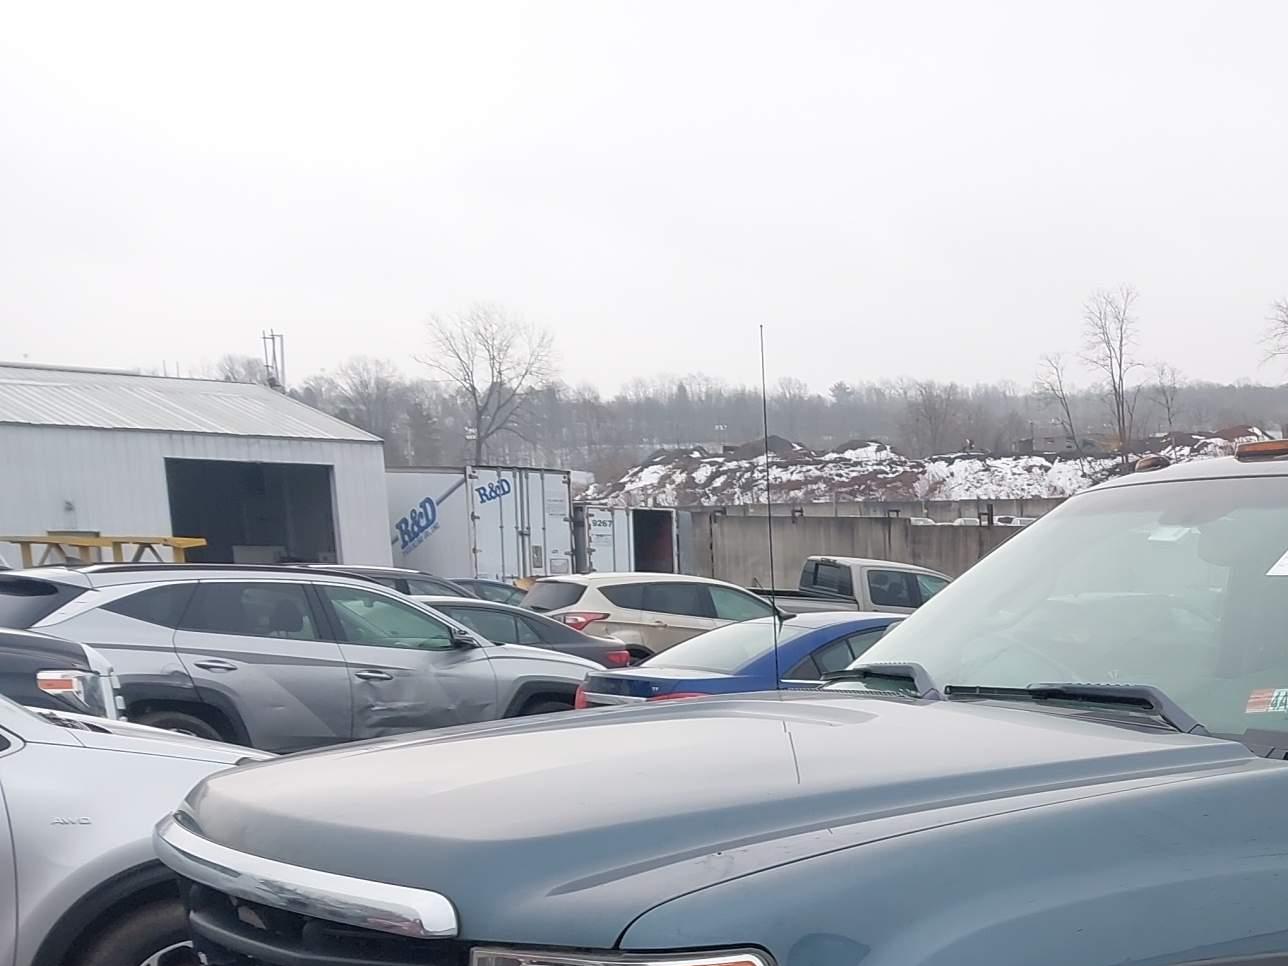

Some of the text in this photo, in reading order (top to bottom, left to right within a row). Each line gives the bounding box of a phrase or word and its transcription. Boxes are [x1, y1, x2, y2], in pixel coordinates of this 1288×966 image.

[475, 478, 512, 504] R&D
[395, 496, 437, 550] R&D
[50, 815, 92, 825] AWD
